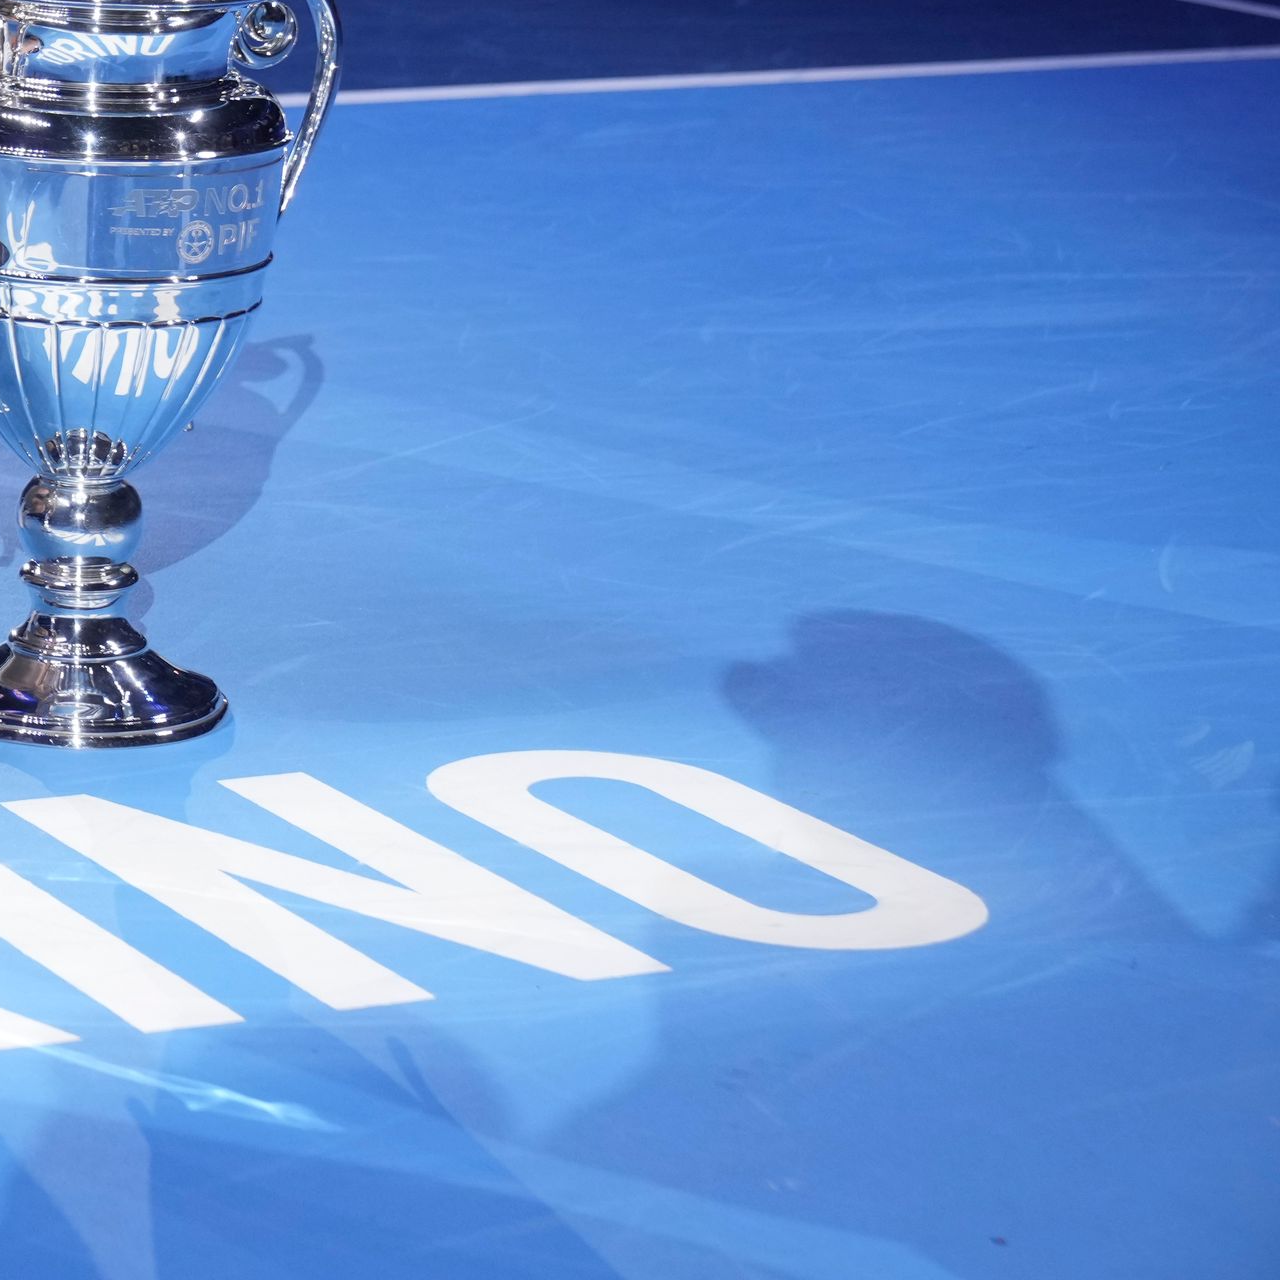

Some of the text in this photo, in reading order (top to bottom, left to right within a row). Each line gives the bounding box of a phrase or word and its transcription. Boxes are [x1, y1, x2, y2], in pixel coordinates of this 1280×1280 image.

[109, 226, 175, 237] PRESENTED BY
[217, 218, 261, 256] PIF
